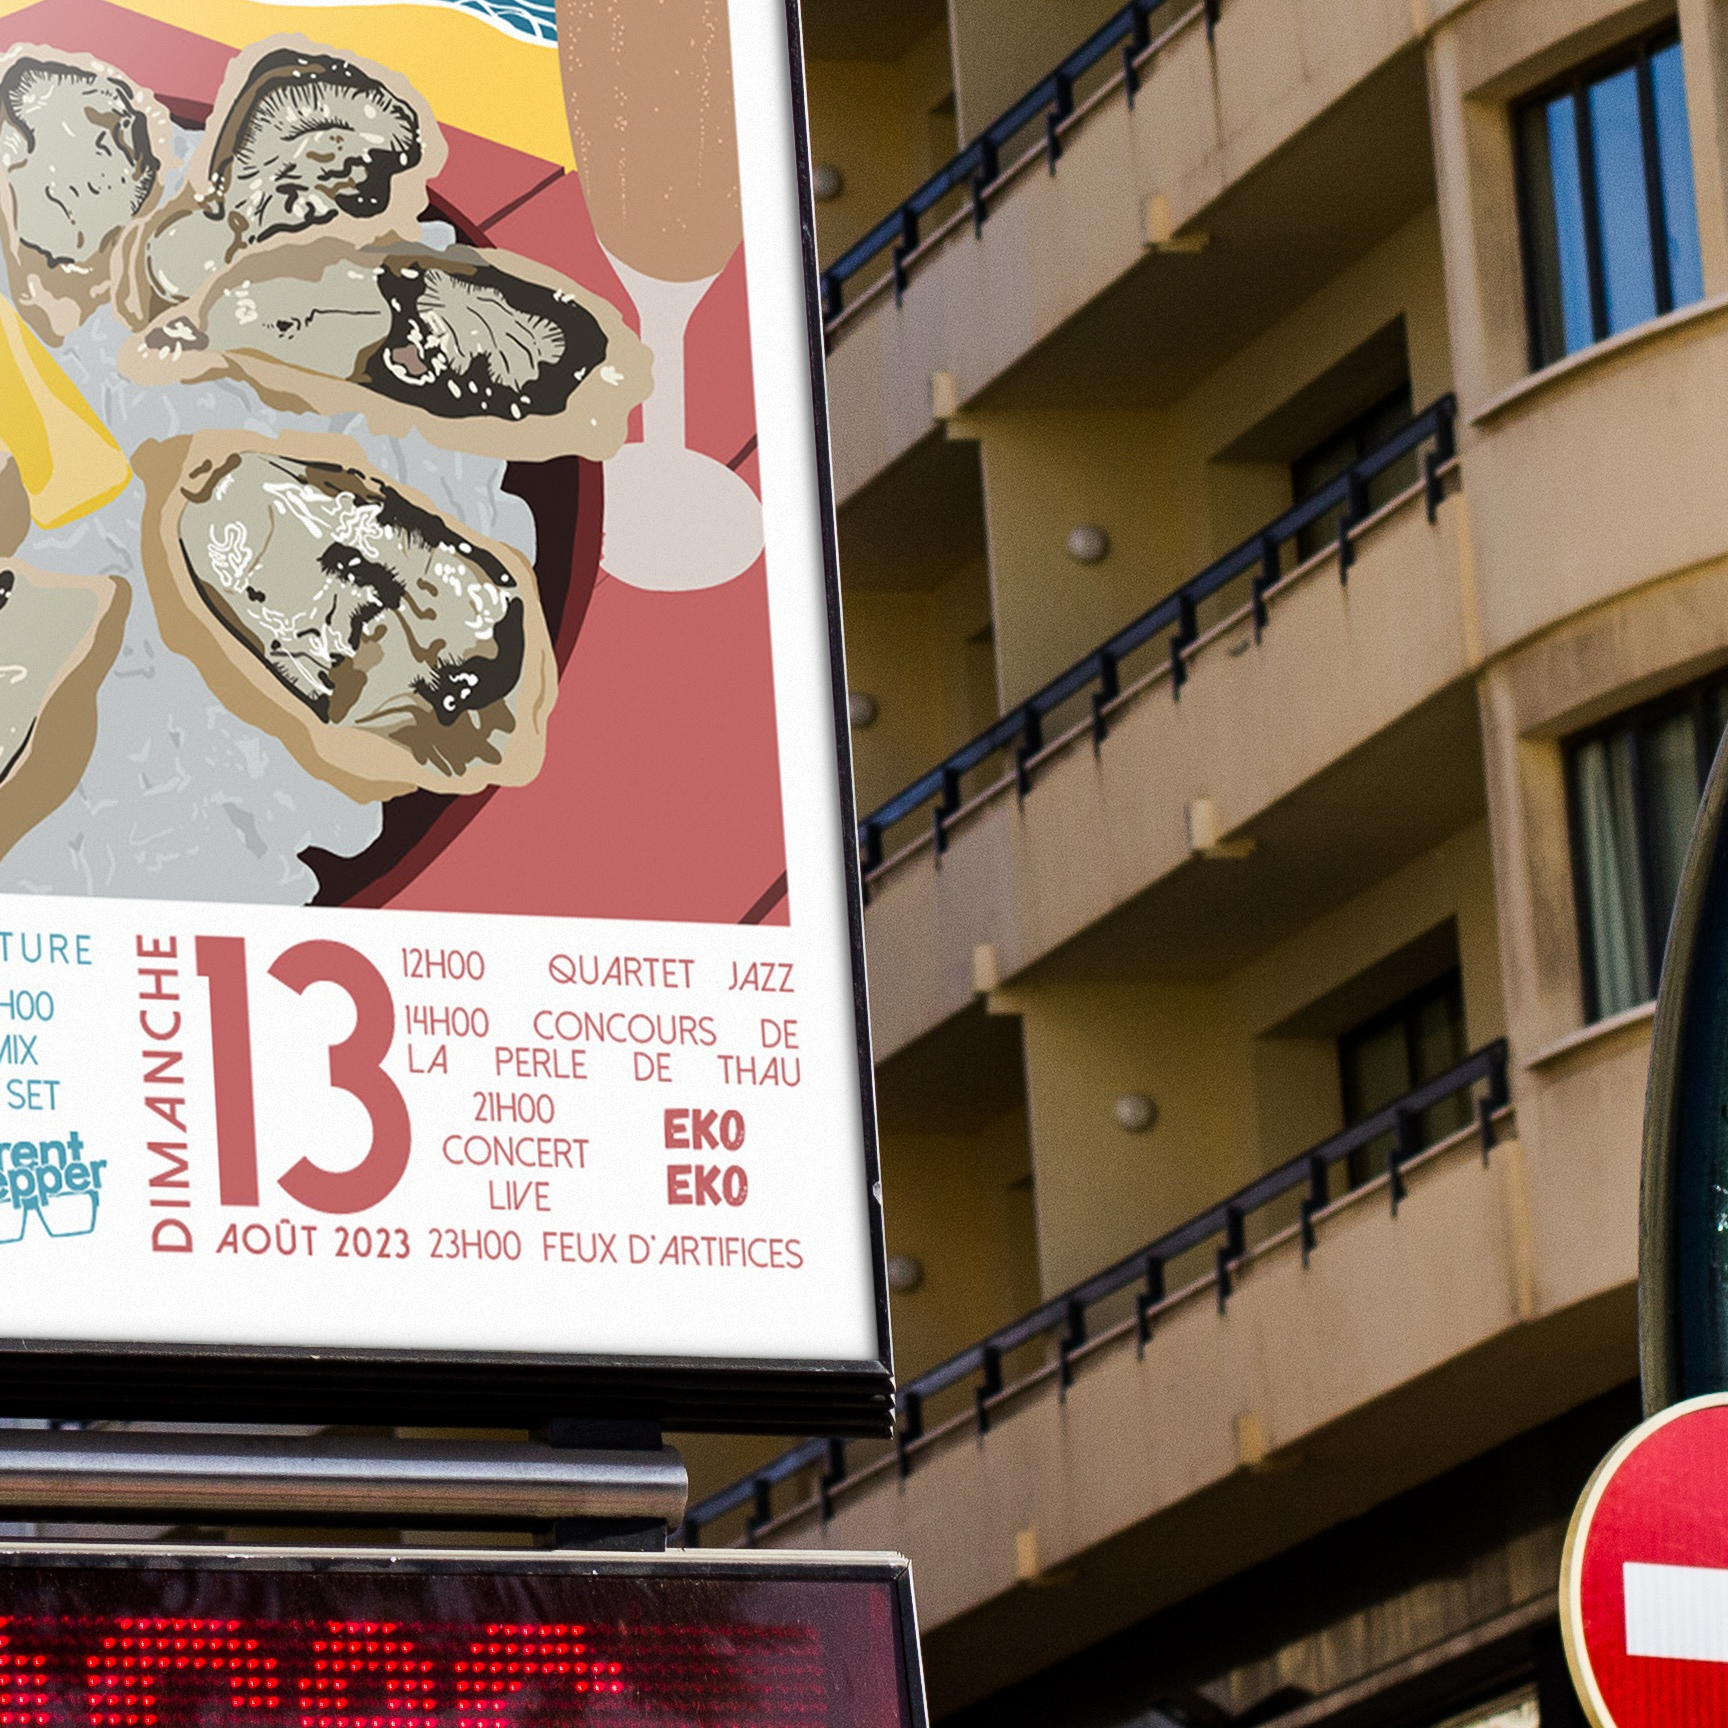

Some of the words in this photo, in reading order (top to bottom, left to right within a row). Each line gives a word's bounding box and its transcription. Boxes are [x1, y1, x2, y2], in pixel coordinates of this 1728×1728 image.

[402, 948, 485, 981] 12H00
[548, 954, 694, 988] QUARTET
[729, 962, 794, 993] JAZZ
[405, 1005, 489, 1038] 14H00
[533, 1011, 717, 1047] CONCOURS
[760, 1018, 799, 1049] DE
[194, 935, 413, 1215] 13
[408, 1044, 448, 1074] LA
[495, 1046, 587, 1079] PERLE
[634, 1051, 672, 1082] DE
[717, 1055, 801, 1087] THAU
[6, 1078, 60, 1110] SET
[136, 934, 194, 1253] DIMANCHE
[474, 1091, 555, 1124] 21H00
[442, 1134, 589, 1168] CONCERT
[664, 1108, 745, 1152] EKO
[489, 1180, 550, 1212] LIVE
[667, 1164, 748, 1207] EKO
[216, 1218, 317, 1256] AOÛT
[335, 1226, 410, 1259] 2023
[429, 1228, 521, 1261] 23H00
[543, 1231, 617, 1263] FEUX
